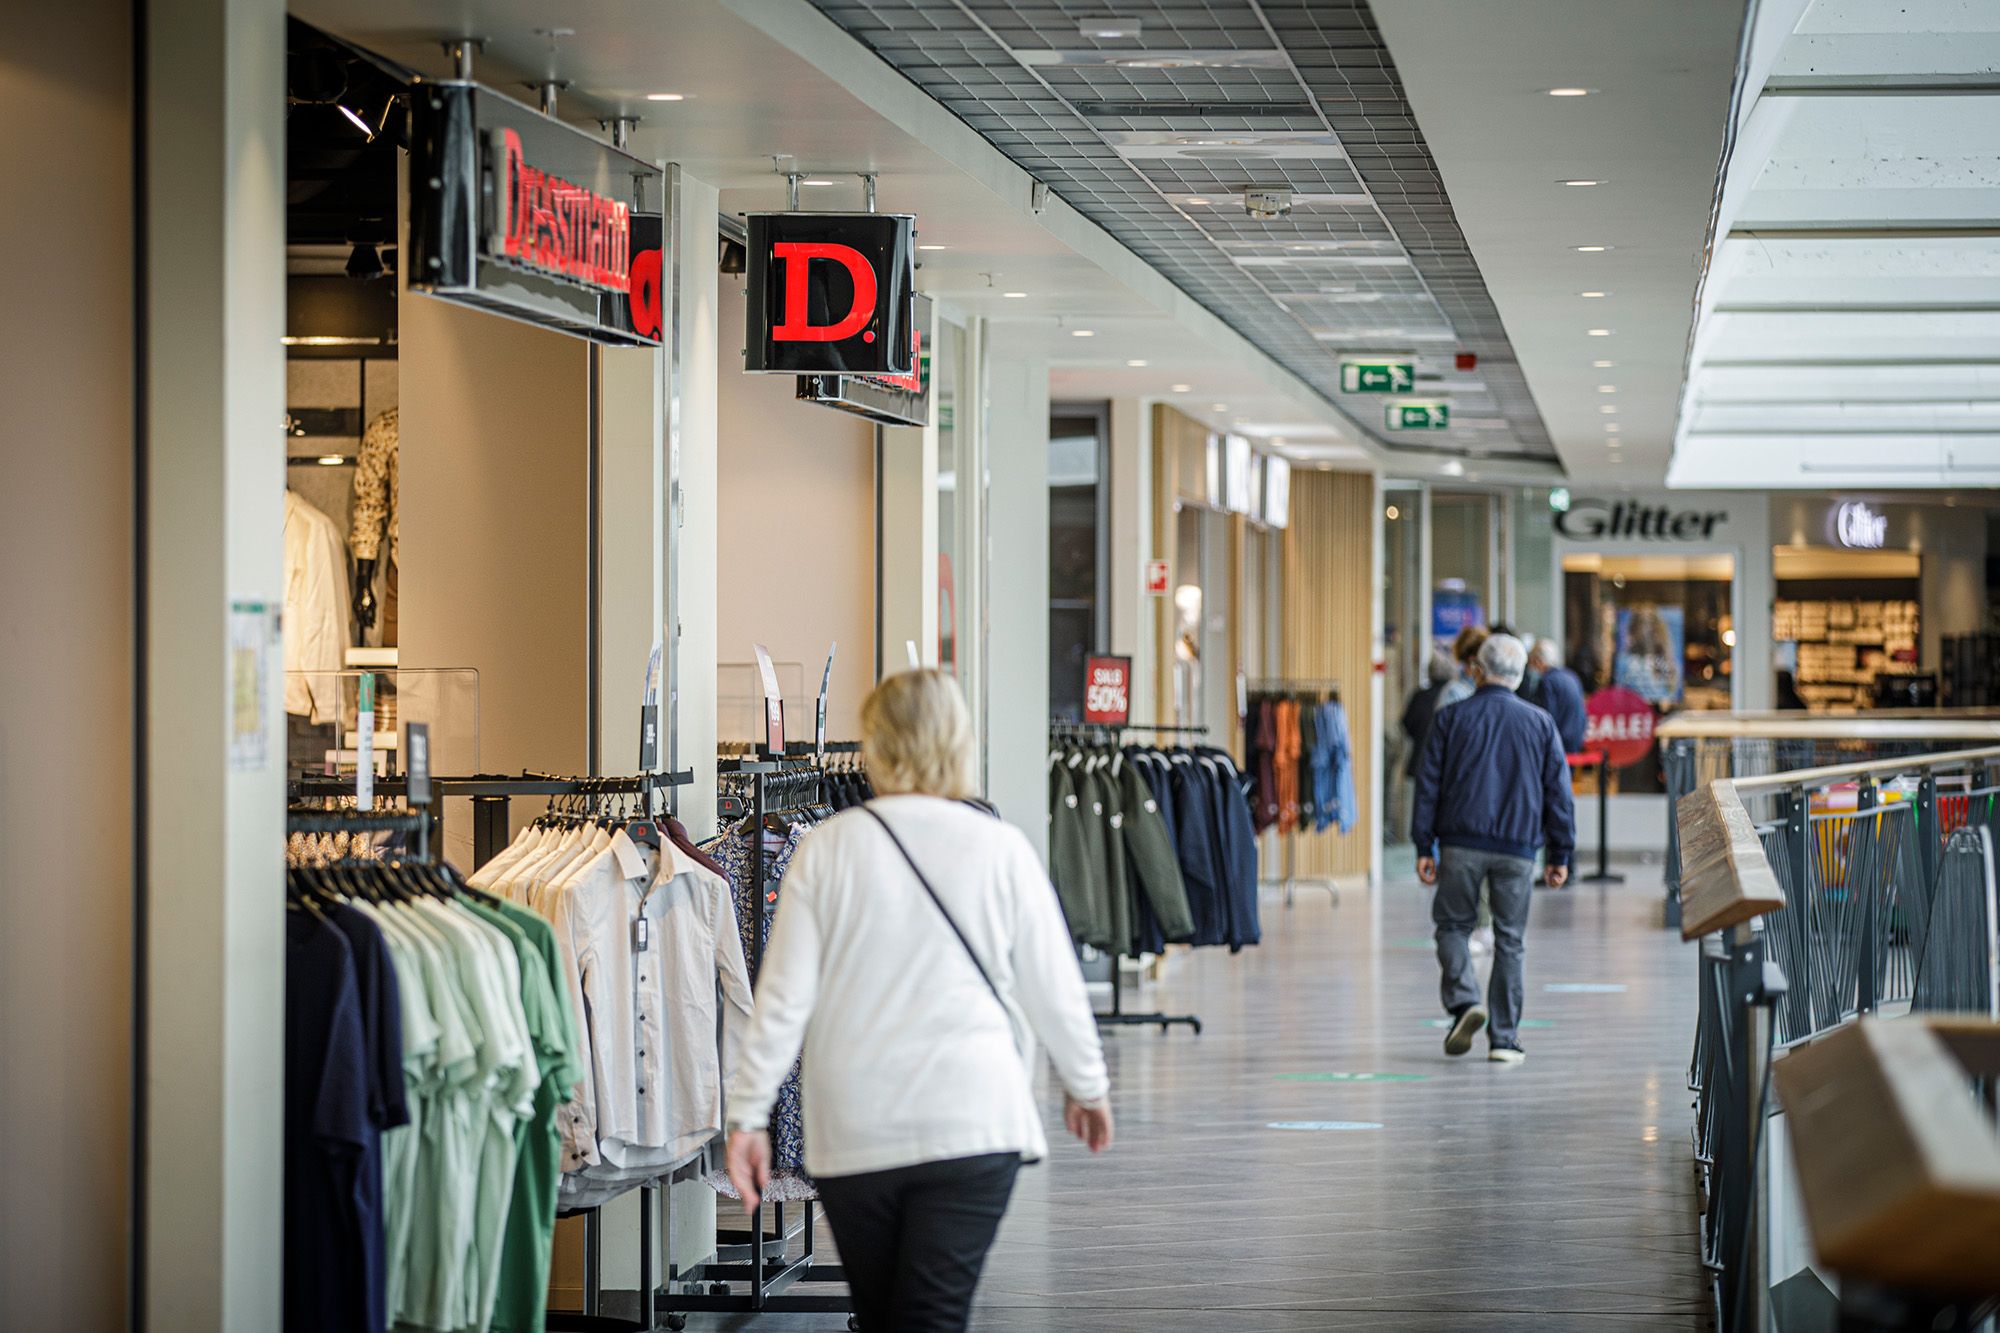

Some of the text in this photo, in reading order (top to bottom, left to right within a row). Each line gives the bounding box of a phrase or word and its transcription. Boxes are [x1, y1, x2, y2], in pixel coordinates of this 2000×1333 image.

[772, 242, 877, 344] D.
[1553, 497, 1728, 541] Glitter
[1087, 685, 1127, 712] 50%
